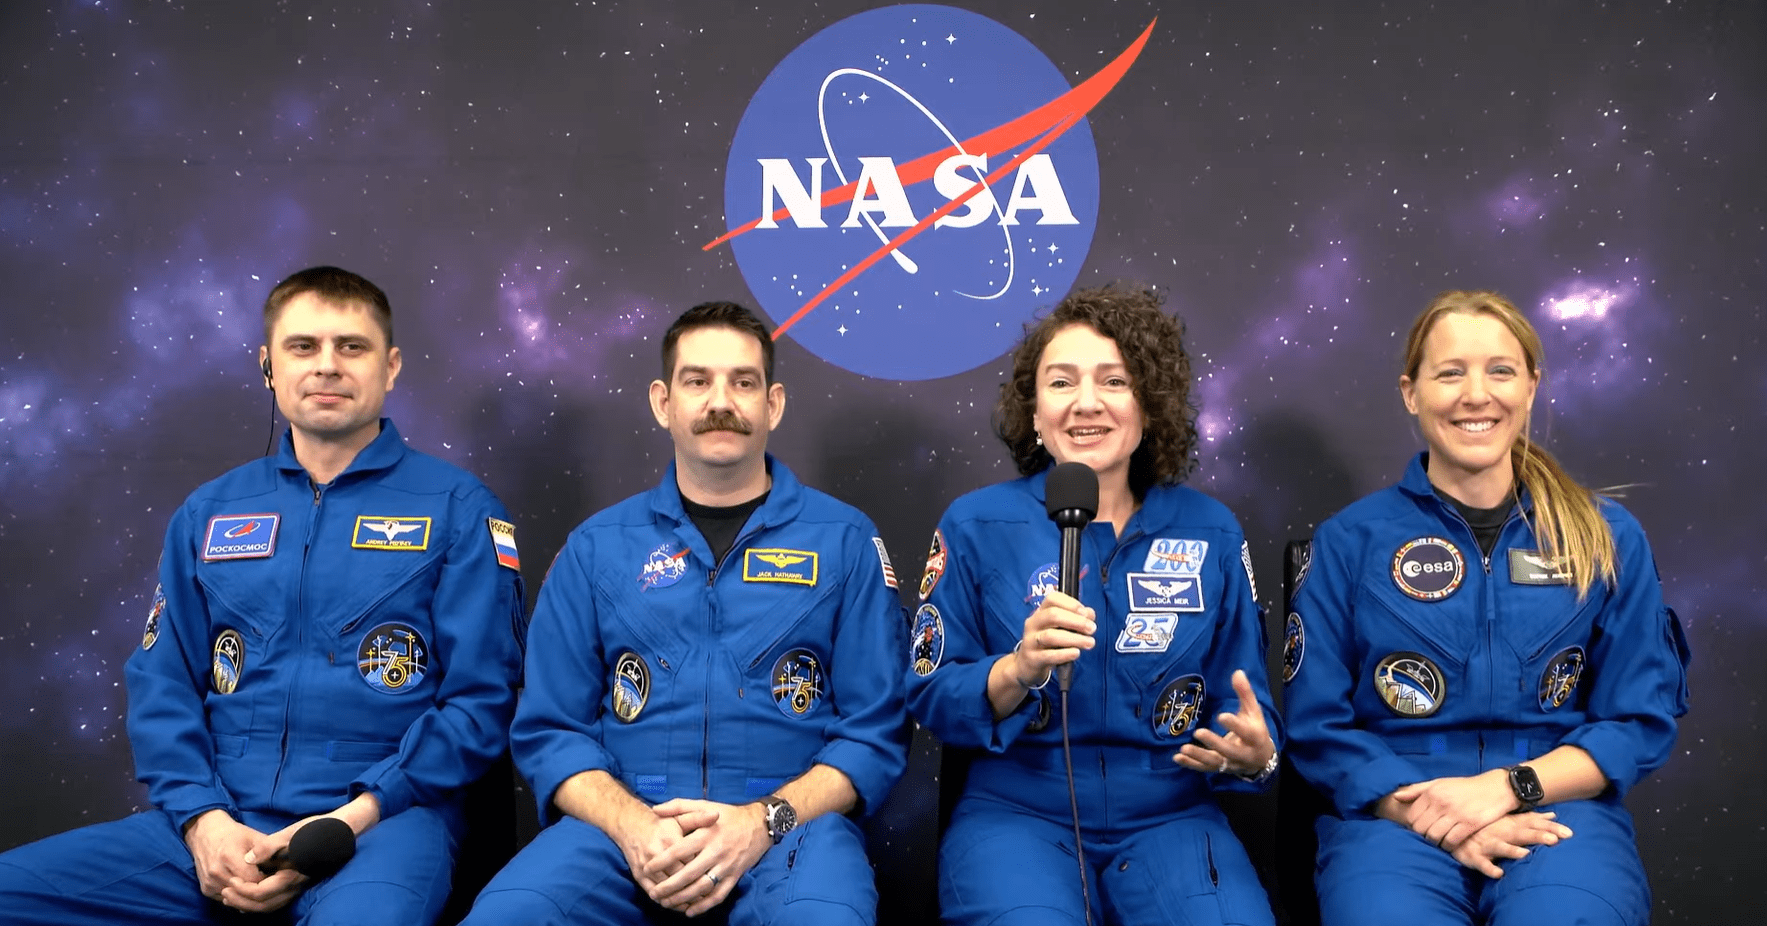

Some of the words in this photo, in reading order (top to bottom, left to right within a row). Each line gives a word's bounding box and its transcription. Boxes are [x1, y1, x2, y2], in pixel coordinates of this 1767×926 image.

[755, 152, 1080, 230] NASA
[210, 543, 268, 553] РОСКОСМОС
[1151, 539, 1204, 572] 200
[643, 557, 686, 575] NASA
[757, 571, 772, 579] JACK
[1422, 560, 1454, 573] esa
[1031, 583, 1059, 597] NA
[1145, 597, 1172, 605] JESSICA
[1173, 597, 1190, 605] MEIR
[1122, 618, 1170, 647] 25
[380, 650, 408, 688] 75
[790, 676, 811, 714] 75
